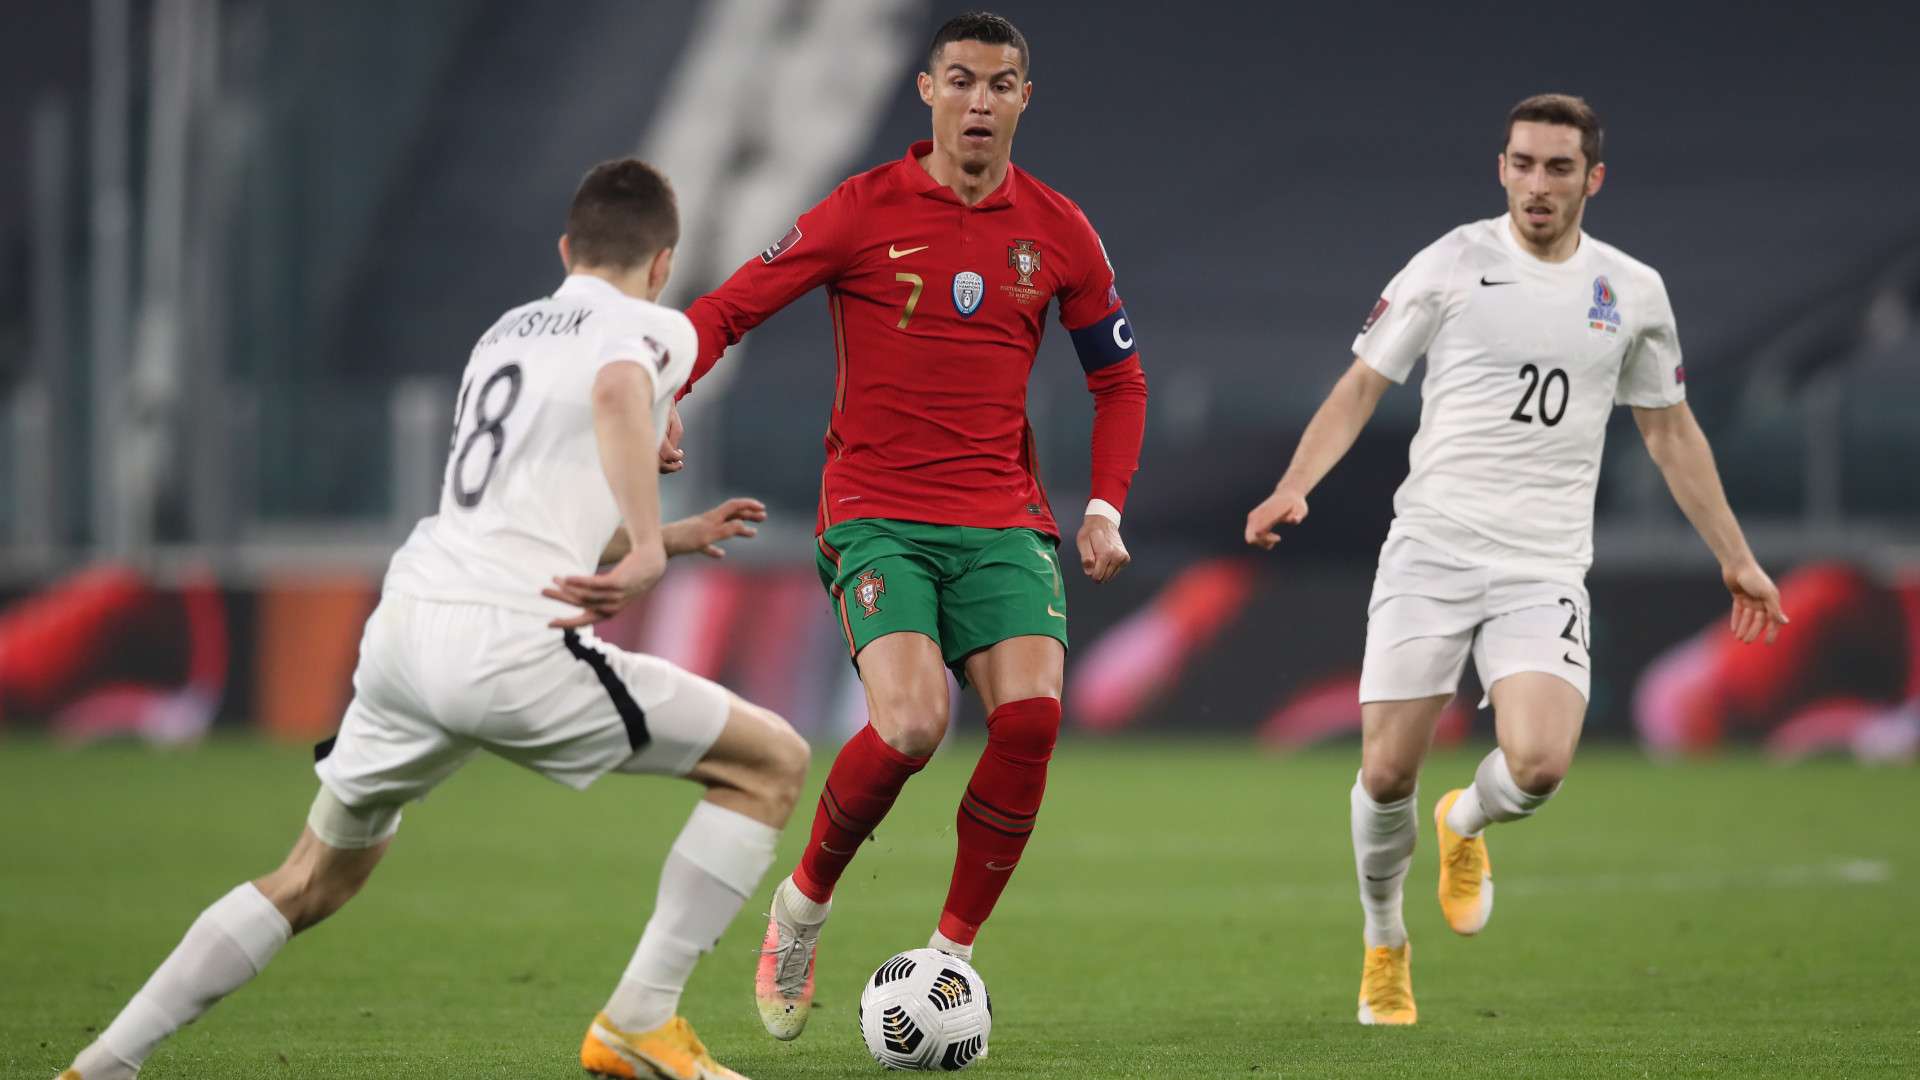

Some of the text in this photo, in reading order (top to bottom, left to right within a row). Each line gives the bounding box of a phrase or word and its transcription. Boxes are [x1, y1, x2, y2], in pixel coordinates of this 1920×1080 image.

[896, 262, 924, 330] 7
[1112, 318, 1134, 350] C
[1510, 363, 1570, 427] 20
